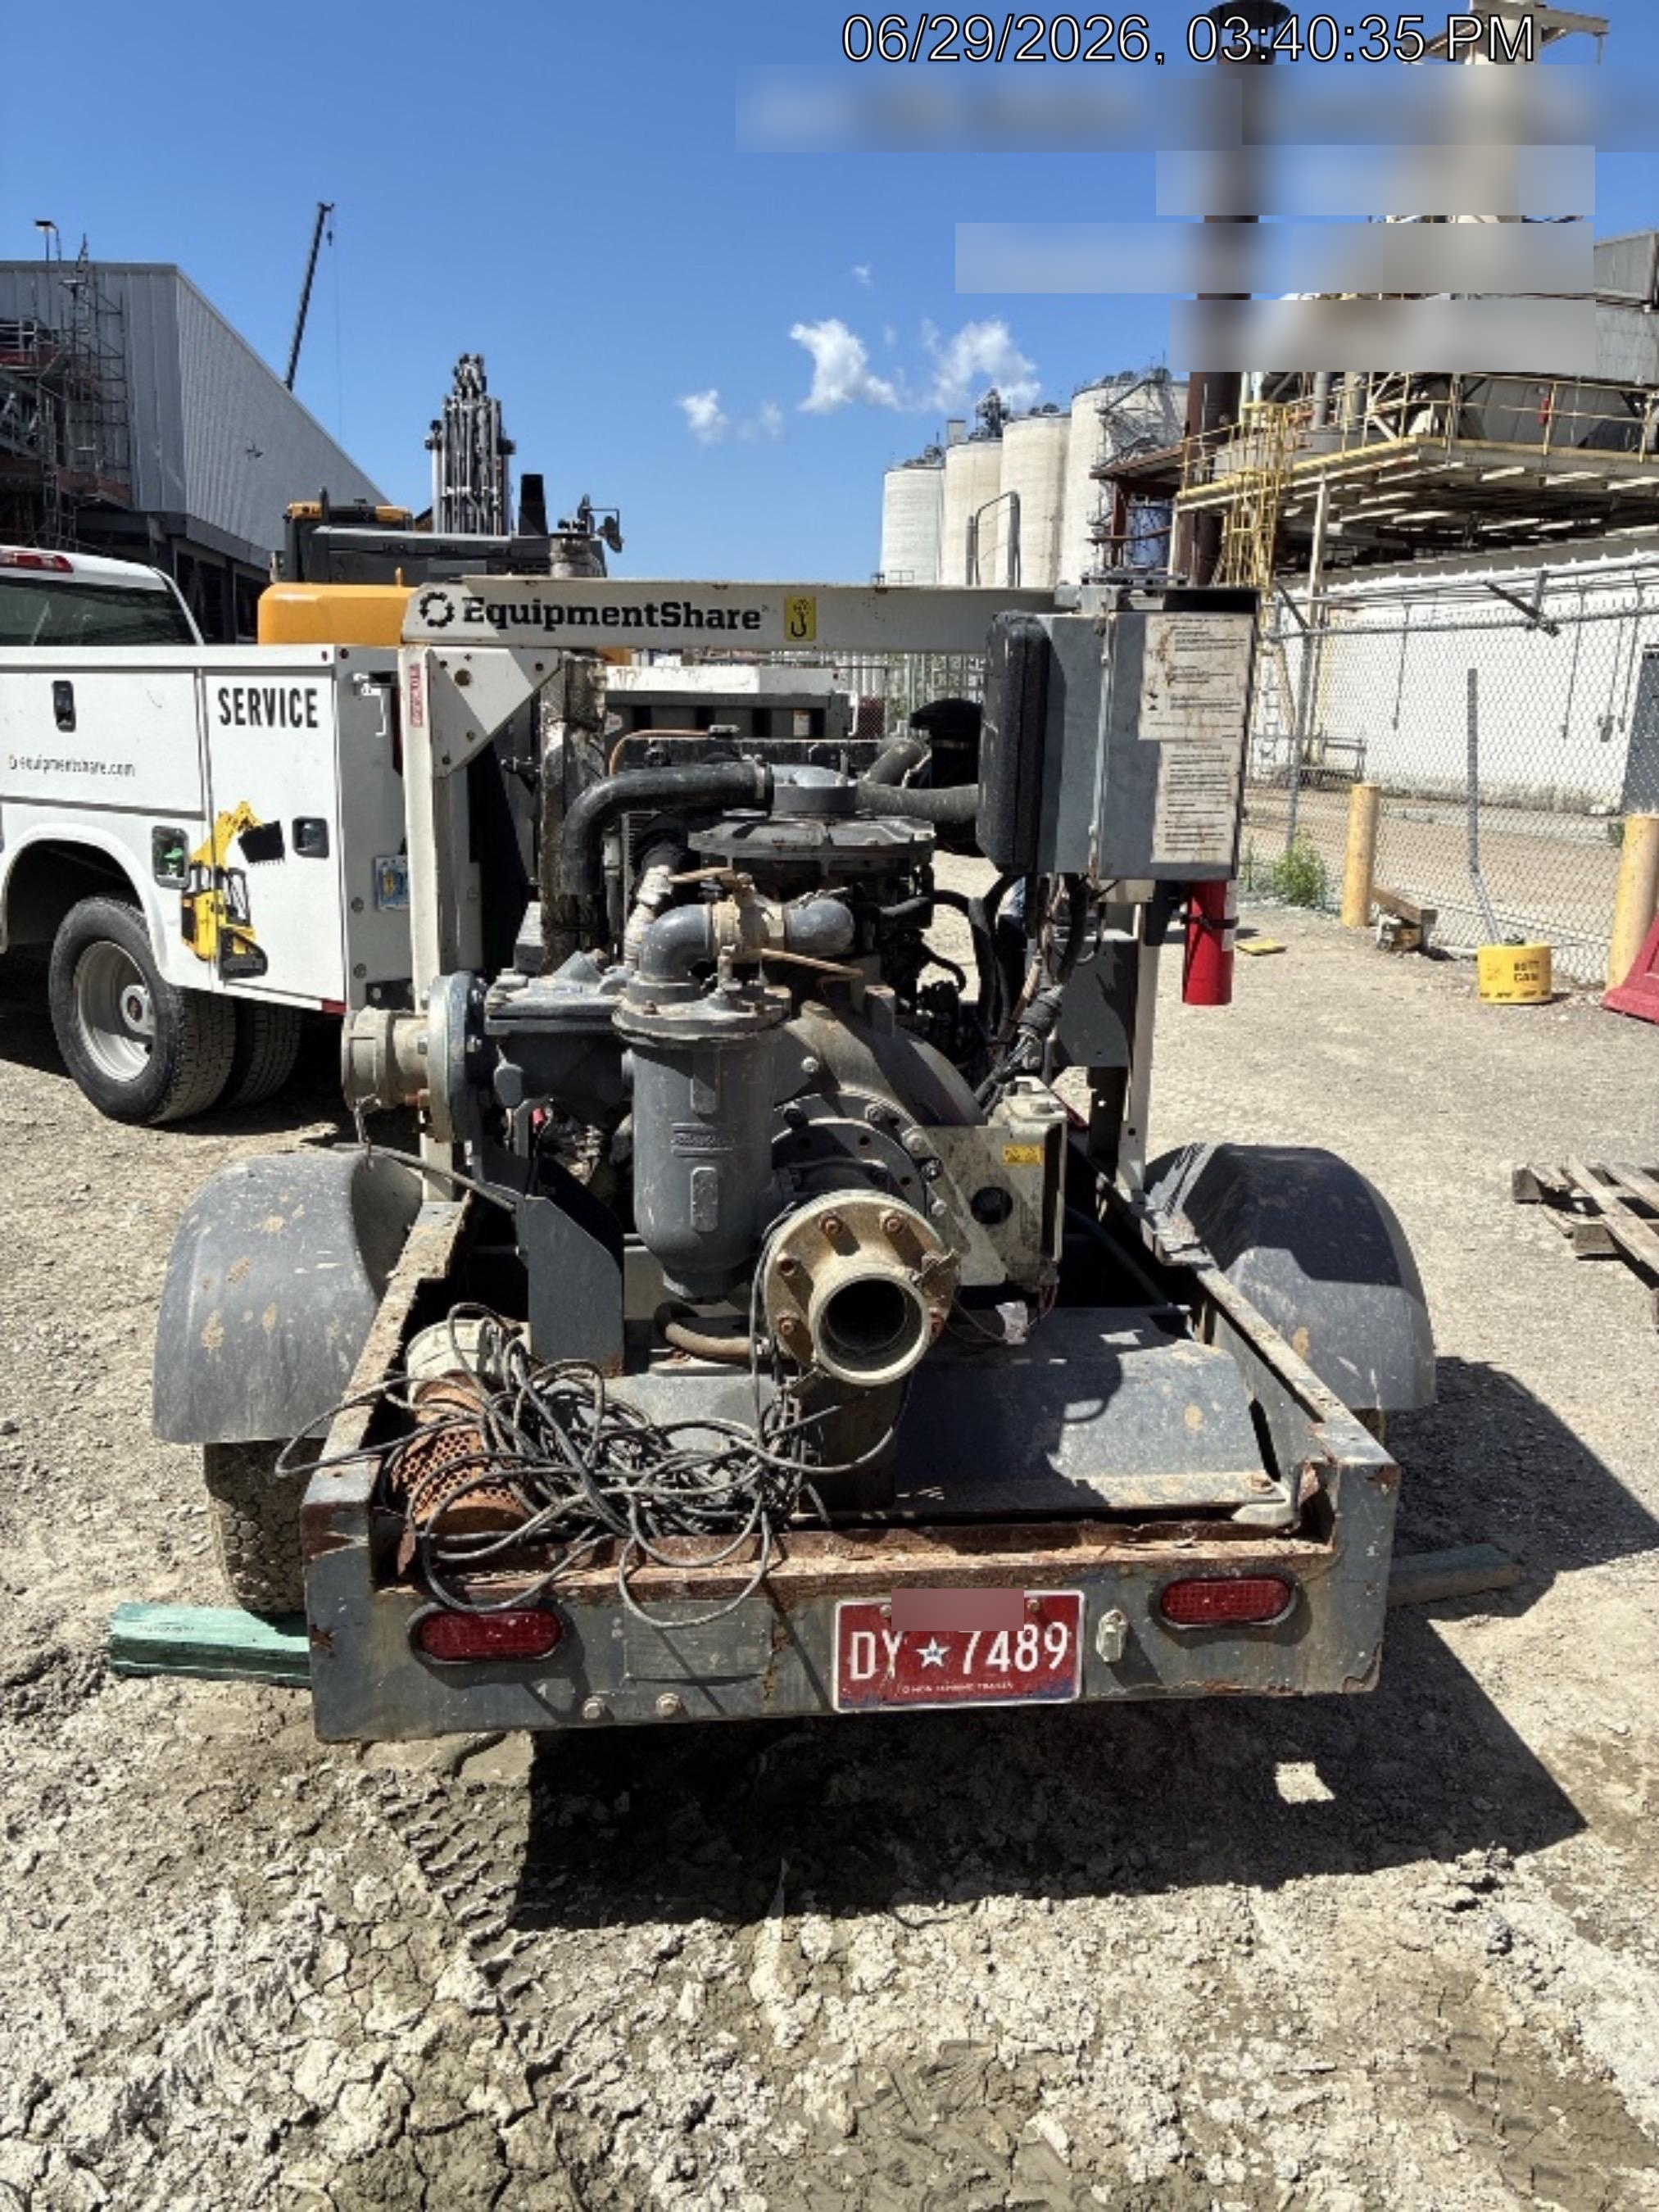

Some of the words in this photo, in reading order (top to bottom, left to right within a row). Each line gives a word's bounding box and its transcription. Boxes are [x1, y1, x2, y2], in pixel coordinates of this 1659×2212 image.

[462, 596, 763, 632] EquipmentShare
[218, 687, 319, 729] SERVICE
[849, 1628, 904, 1680] DY
[958, 1621, 1068, 1675] 7489
